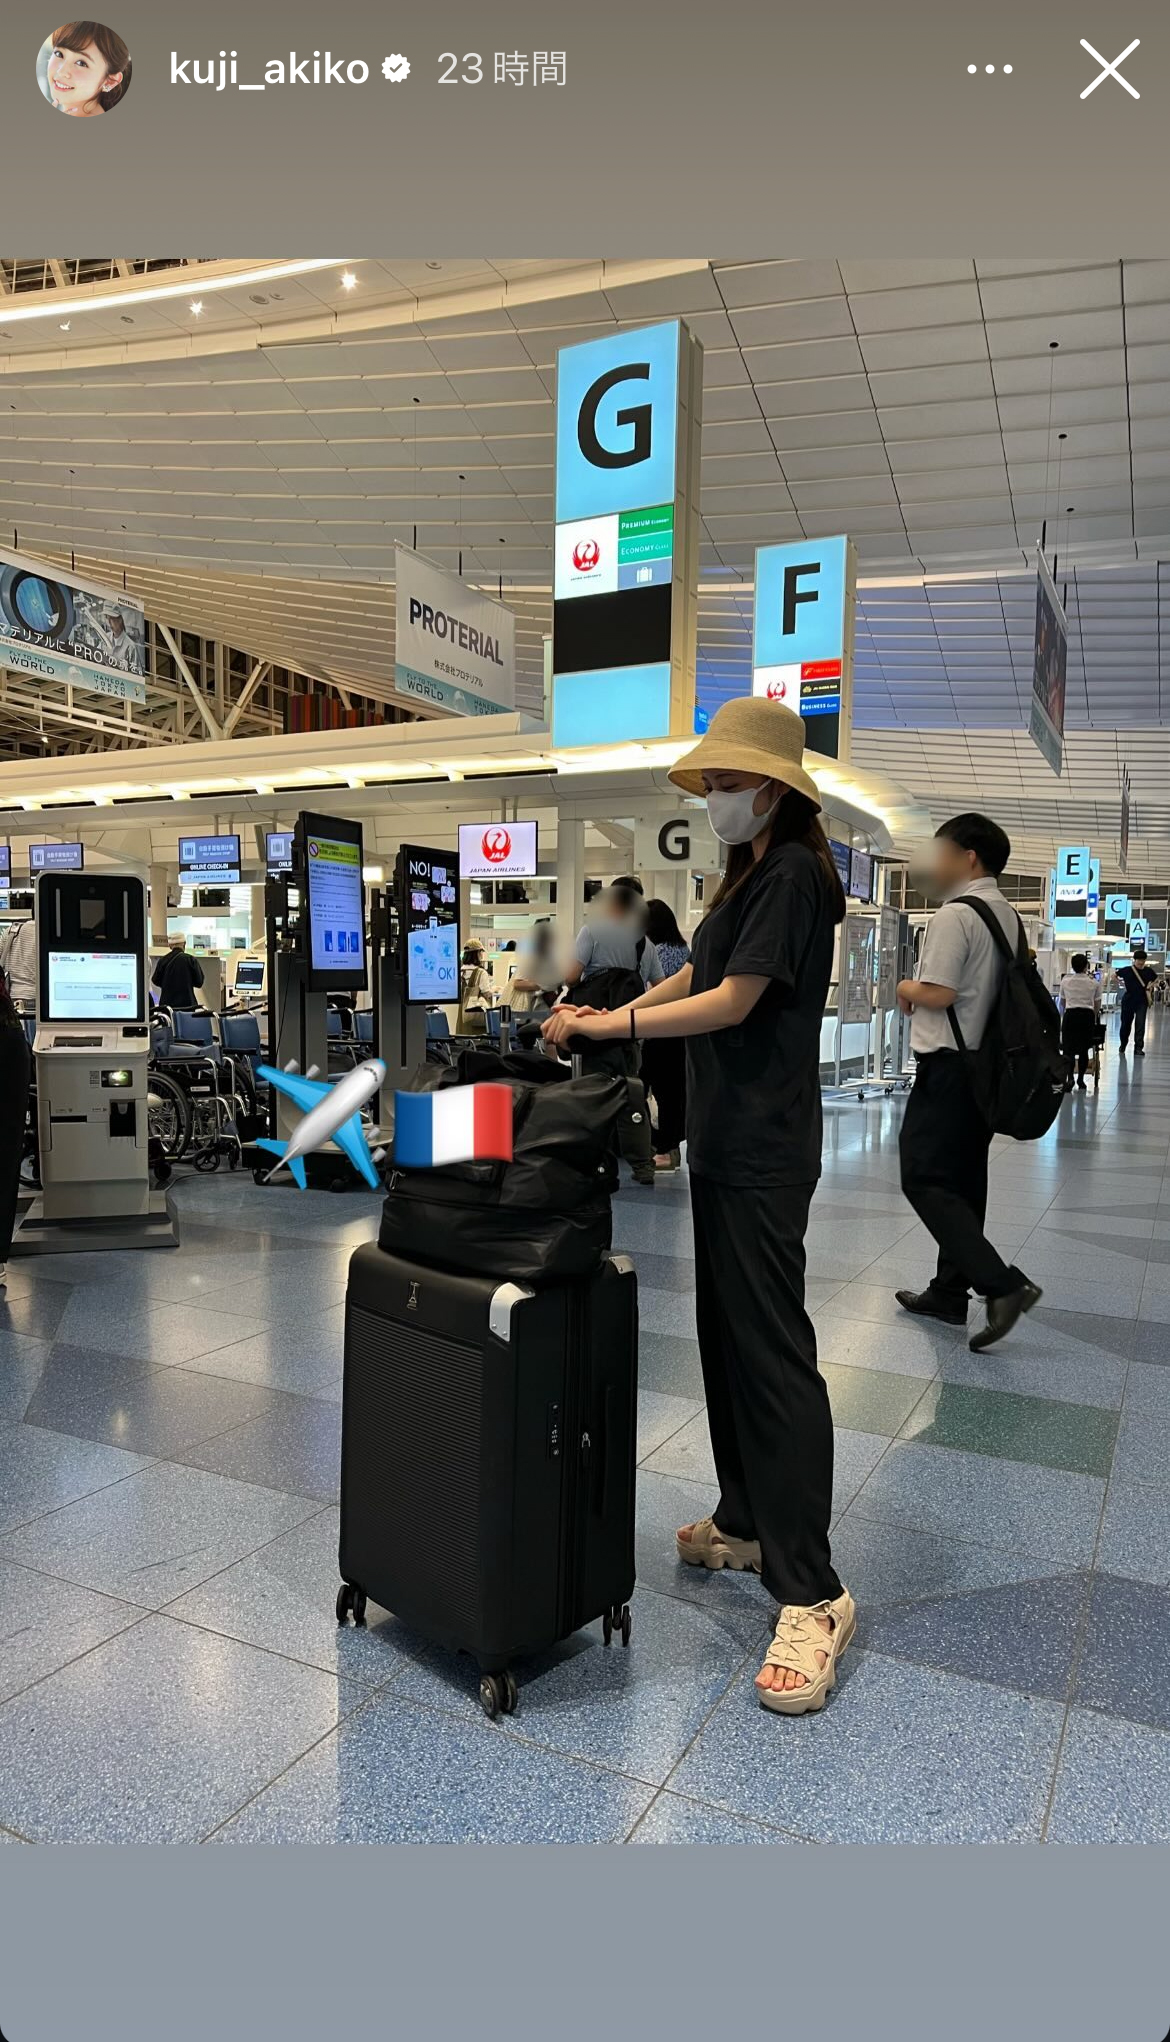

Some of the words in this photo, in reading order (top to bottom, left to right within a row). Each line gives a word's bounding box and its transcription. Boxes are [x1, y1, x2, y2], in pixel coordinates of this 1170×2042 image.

[577, 362, 652, 469] G
[621, 519, 650, 530] PREMIUM
[621, 544, 653, 556] ECONOMY
[782, 562, 821, 635] F
[409, 597, 504, 666] PROTERIAL
[9, 655, 55, 675] WORLD
[94, 679, 126, 692] TOKYO
[94, 686, 126, 697] JAPAN
[407, 679, 444, 701] WORLD
[657, 819, 690, 861] G
[409, 860, 431, 877] NO!
[1066, 854, 1081, 876] E
[1110, 899, 1123, 914] C
[1133, 923, 1144, 933] A
[438, 967, 456, 981] OK!
